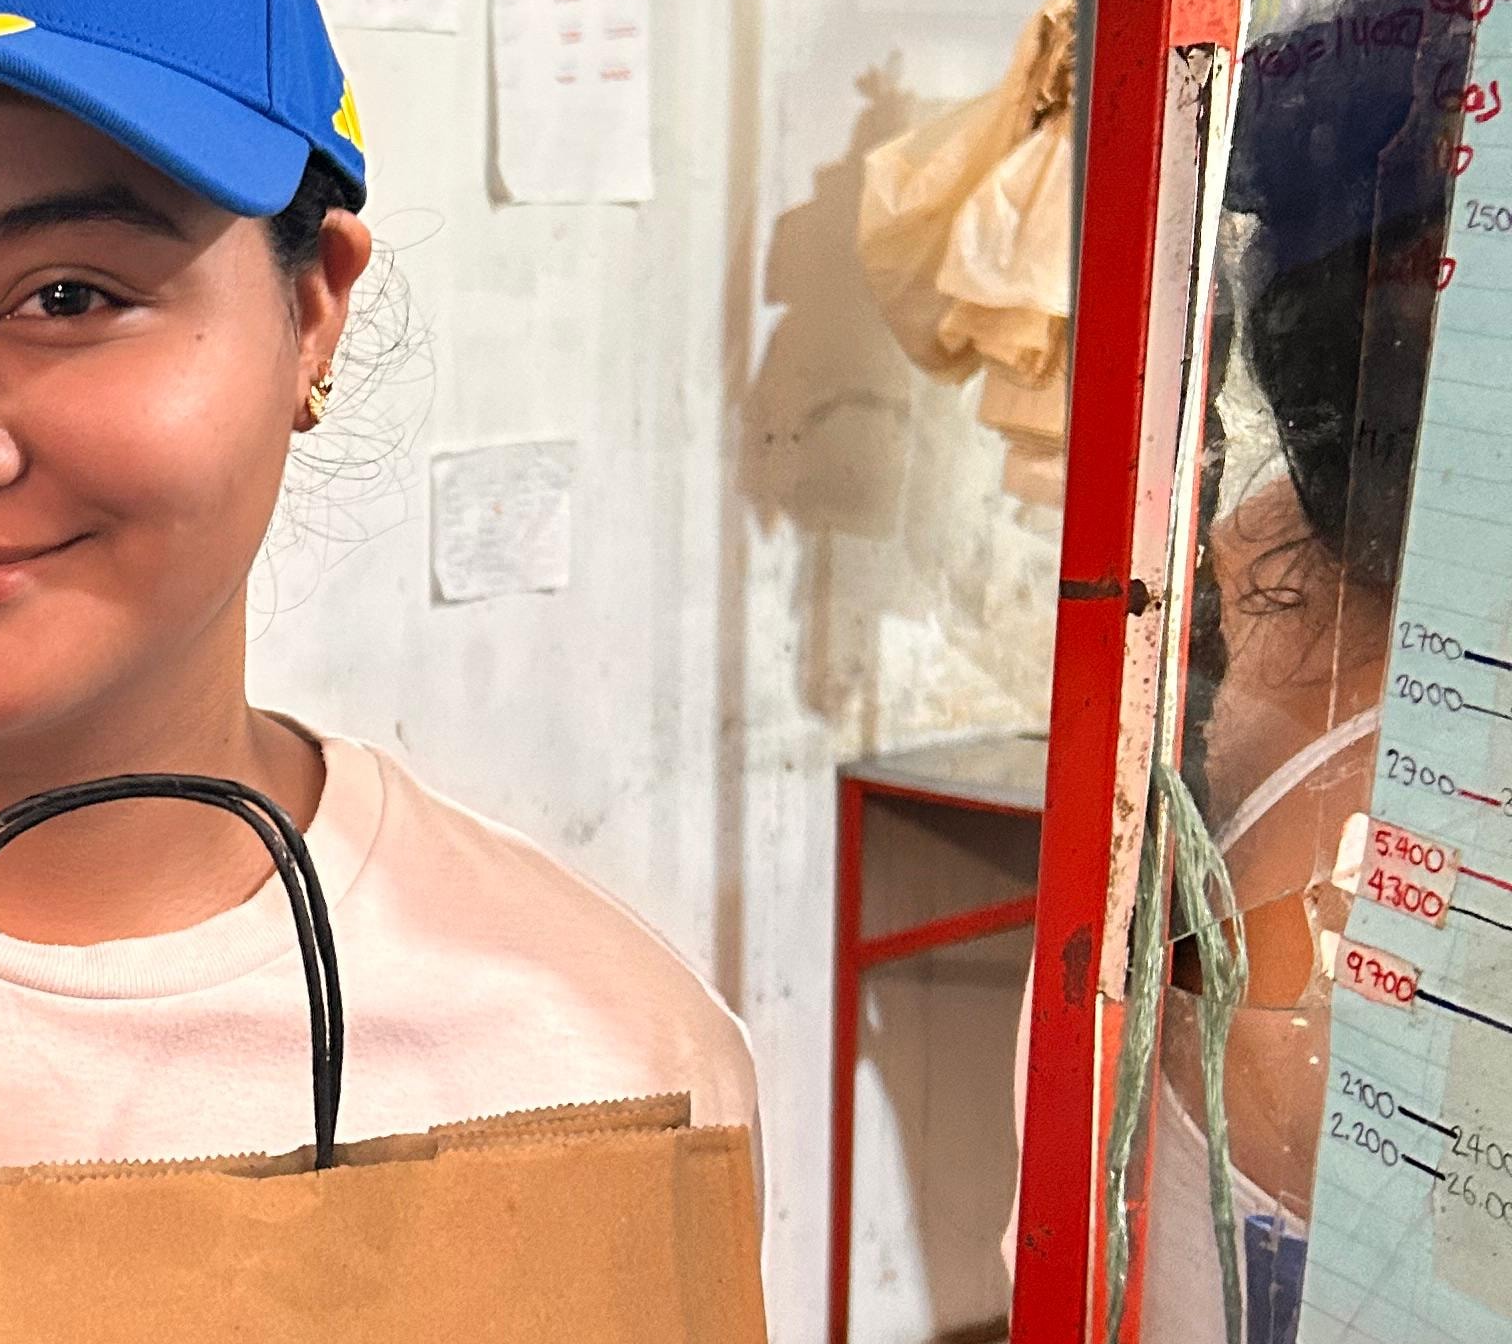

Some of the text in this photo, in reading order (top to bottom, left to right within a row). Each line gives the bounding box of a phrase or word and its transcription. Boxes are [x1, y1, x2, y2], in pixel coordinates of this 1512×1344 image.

[1398, 621, 1464, 662] 2700
[1396, 674, 1464, 712] 2000
[1374, 830, 1445, 874] 5.400
[1346, 950, 1416, 1003] 9700
[1340, 1071, 1395, 1119] 2100
[1330, 1112, 1399, 1167] 2.200
